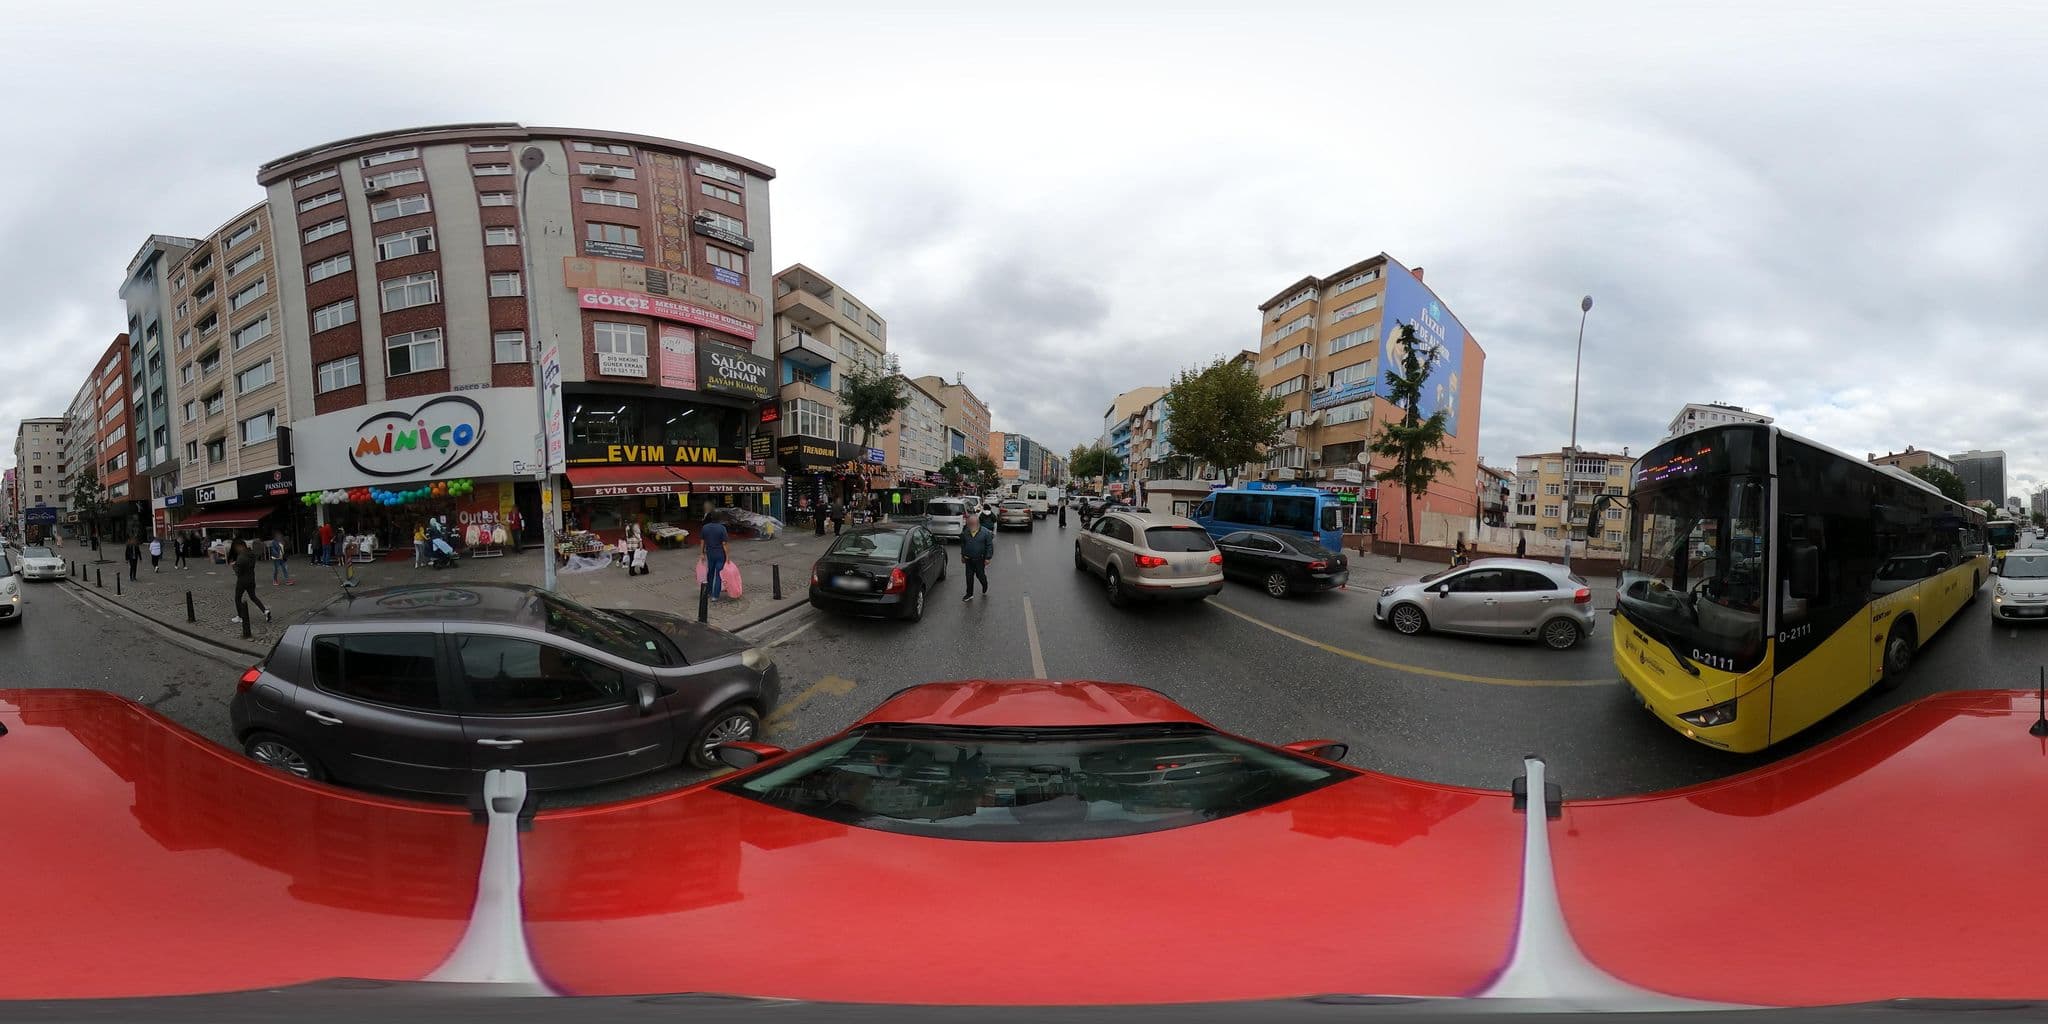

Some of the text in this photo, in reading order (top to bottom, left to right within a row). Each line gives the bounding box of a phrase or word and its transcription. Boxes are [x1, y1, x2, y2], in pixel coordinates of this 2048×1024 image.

[583, 291, 650, 313] GÖKÇE
[655, 300, 690, 313] MESLEK
[711, 353, 767, 378] SALOON
[708, 375, 735, 386] BAYAN
[718, 366, 759, 384] ÇINAR
[675, 447, 717, 463] AVM
[595, 484, 673, 495] EVİM ÇARŞI
[459, 510, 499, 525] Outet
